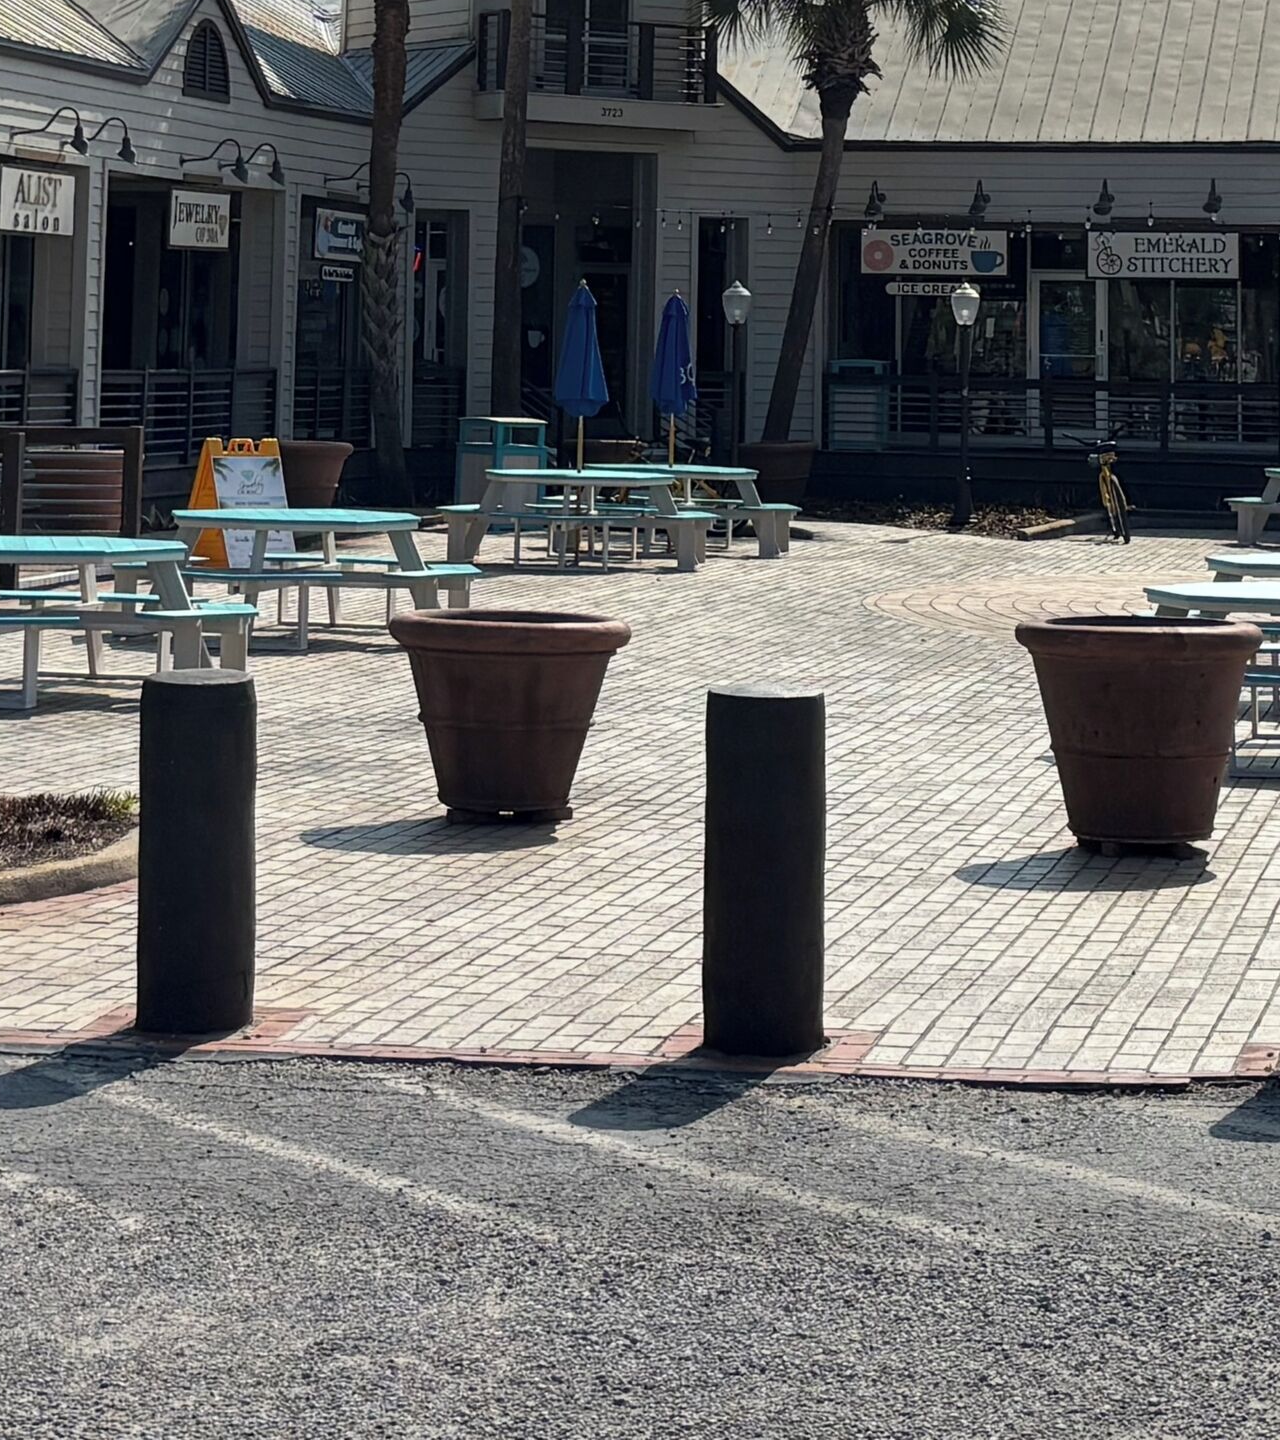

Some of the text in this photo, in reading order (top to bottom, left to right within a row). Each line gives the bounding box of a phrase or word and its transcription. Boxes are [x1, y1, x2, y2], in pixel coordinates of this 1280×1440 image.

[14, 172, 62, 208] ALIST
[13, 208, 60, 232] salon
[890, 232, 978, 248] SEAGROVE
[1134, 237, 1226, 253] EMERALD
[909, 248, 960, 259] COFFEE
[899, 260, 969, 271] & DONUTS
[1127, 257, 1232, 273] STITCHERY
[897, 284, 961, 294] ICE CREA
